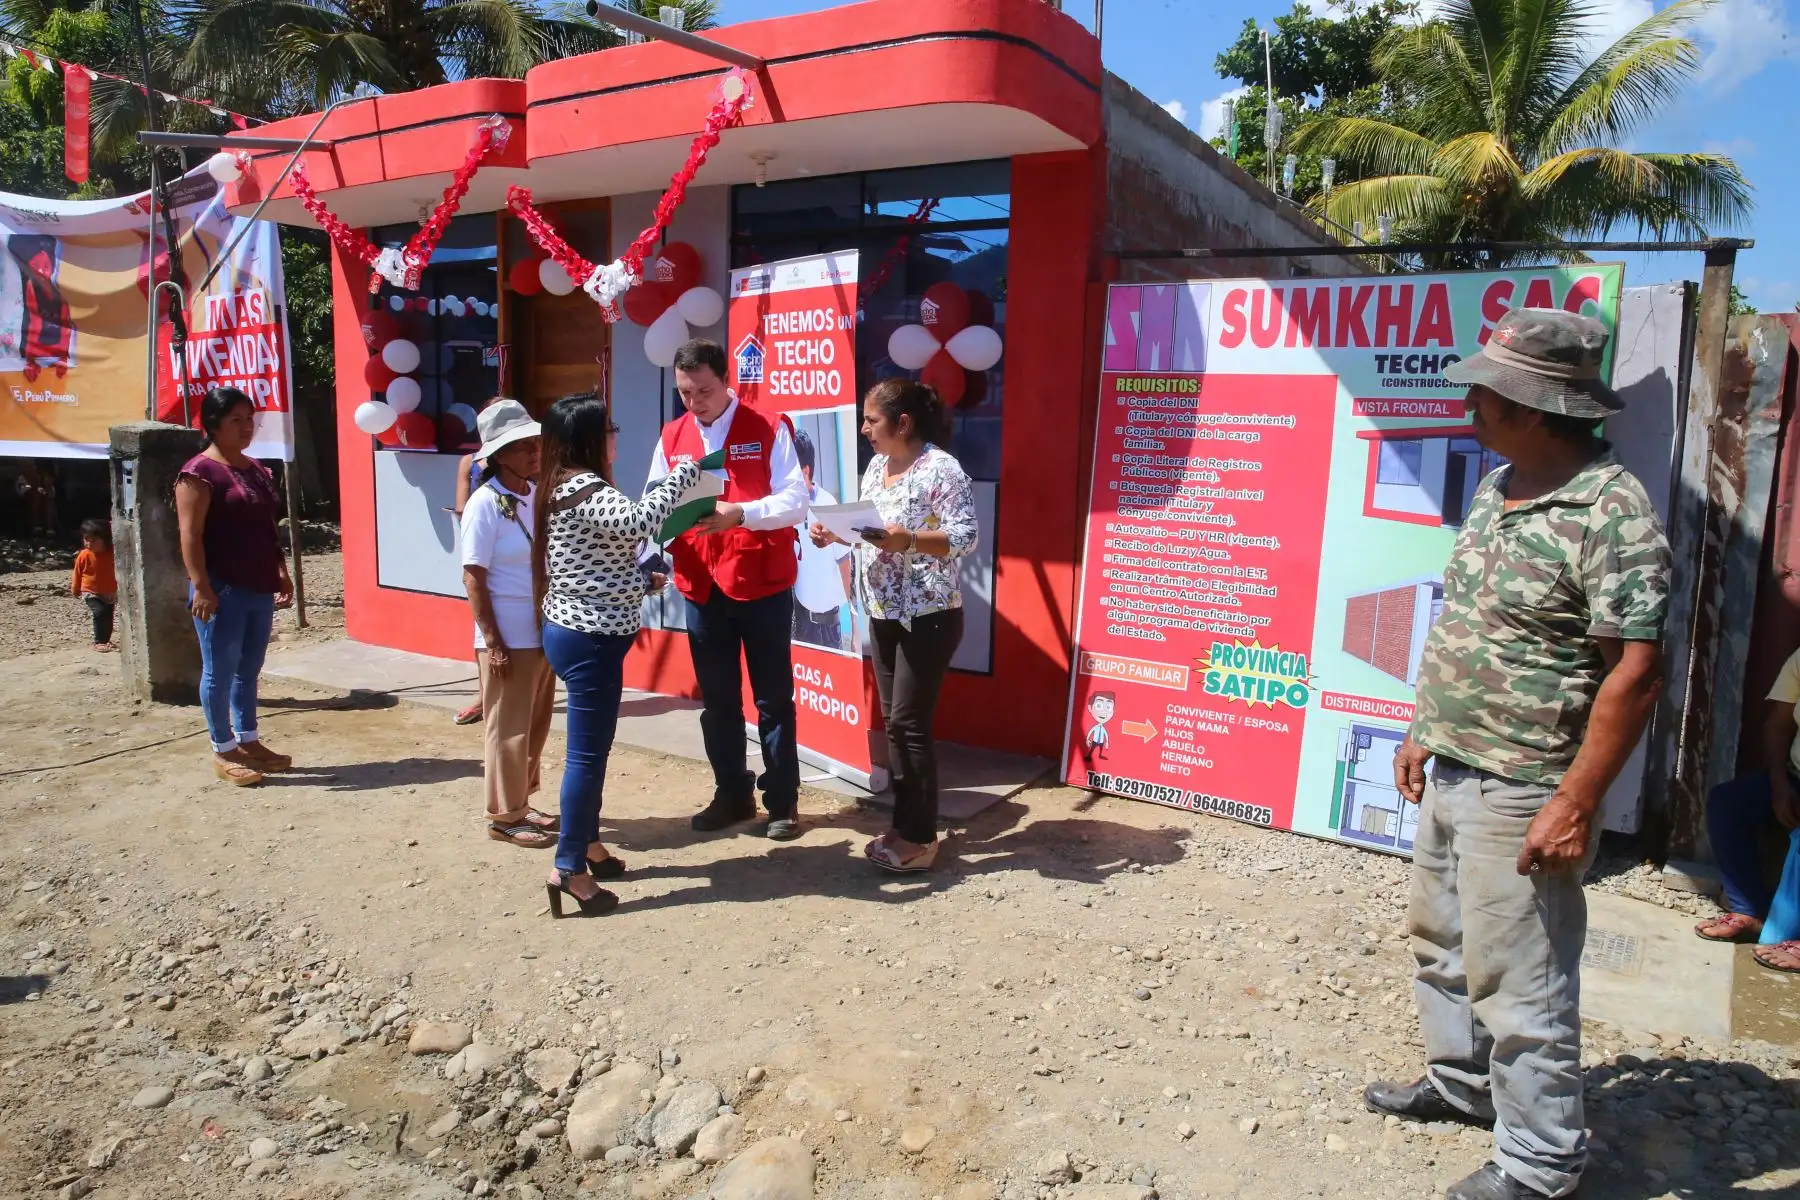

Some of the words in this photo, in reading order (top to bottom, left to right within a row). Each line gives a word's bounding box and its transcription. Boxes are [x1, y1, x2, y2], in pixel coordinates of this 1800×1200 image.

[763, 308, 834, 335] TENEMOS
[838, 315, 852, 330] UN
[1219, 284, 1454, 348] SUMKHA
[774, 338, 835, 365] TECHO
[177, 383, 207, 397] PRA
[770, 370, 841, 396] SEGURO
[1116, 378, 1201, 392] REQUISITOS:
[1128, 398, 1157, 408] Copia
[1160, 399, 1176, 407] del
[1180, 399, 1199, 408] DNI
[1357, 401, 1389, 413] VISTA
[1392, 402, 1450, 415] FRONTAL
[1128, 412, 1166, 422] (Titular
[1166, 414, 1174, 423] y
[1177, 413, 1296, 427] cónyuge/conviviente)
[1124, 439, 1165, 450] familiar.
[1125, 427, 1155, 437] Copia
[1158, 427, 1174, 437] del
[1177, 428, 1196, 438] DNI
[1200, 429, 1212, 439] de
[1214, 430, 1225, 439] la
[1228, 432, 1260, 442] carga
[1123, 455, 1153, 465] Copia
[1156, 456, 1188, 466] Literal
[1191, 458, 1205, 467] de
[1208, 459, 1261, 471] Registros
[1122, 466, 1167, 478] Públicos
[1170, 469, 1220, 482] (vigente).
[1120, 481, 1173, 494] Búsqueda
[1176, 485, 1223, 497] Registral
[1227, 490, 1234, 498] a
[1237, 490, 1263, 500] nivel
[1119, 495, 1163, 506] nacional
[1166, 497, 1203, 509] (Titular
[1205, 501, 1213, 510] y
[1114, 524, 1168, 537] Autovalúo
[1179, 530, 1195, 539] PU
[1199, 531, 1207, 540] Y
[1209, 532, 1225, 542] HR
[1228, 534, 1280, 549] (vigente).
[1113, 539, 1149, 551] Recibo
[1153, 544, 1165, 553] de
[1168, 544, 1187, 555] Luz
[1189, 548, 1197, 557] y
[1199, 549, 1231, 560] Agua.
[1113, 555, 1142, 566] Firma
[1144, 558, 1160, 567] del
[1163, 561, 1207, 572] contrato
[1210, 566, 1231, 575] con
[1234, 566, 1243, 576] la
[1246, 568, 1267, 579] E.T.
[1111, 569, 1153, 583] Realizar
[1155, 575, 1191, 587] trámite
[1194, 579, 1208, 588] de
[1211, 580, 1277, 596] Elegibilidad
[1110, 583, 1123, 592] en
[1125, 585, 1139, 593] un
[1142, 585, 1176, 598] Centro
[1179, 590, 1241, 606] Autorizado.
[1109, 597, 1123, 607] No
[1126, 599, 1156, 611] haber
[1158, 603, 1181, 614] sido
[1183, 606, 1247, 622] beneficiario
[1250, 615, 1271, 626] por
[1108, 610, 1136, 622] algún
[1139, 614, 1189, 629] programa
[1192, 621, 1206, 630] de
[1209, 622, 1255, 637] vivienda
[1108, 625, 1124, 635] del
[1127, 628, 1166, 641] Estado.
[1087, 658, 1127, 677] GRUPO
[1129, 663, 1182, 684] FAMILIAR
[1209, 643, 1308, 679] PROVINCIA
[824, 674, 833, 691] A
[1205, 671, 1310, 708] SATIPO
[800, 686, 859, 726] PROPIO
[1325, 695, 1412, 718] DISTRIBUICION
[1167, 704, 1235, 724] CONVIVIENTE
[1244, 717, 1289, 733] ESPOSA
[1197, 721, 1229, 735] MAMA
[1164, 727, 1194, 741] HIJOS
[1162, 739, 1205, 755] ABUELO
[1160, 762, 1191, 776] NIETO
[1161, 751, 1214, 769] HERMANO
[1087, 771, 1113, 788] Telf:
[1114, 776, 1182, 804] 929707527
[1192, 793, 1271, 824] 964486825
